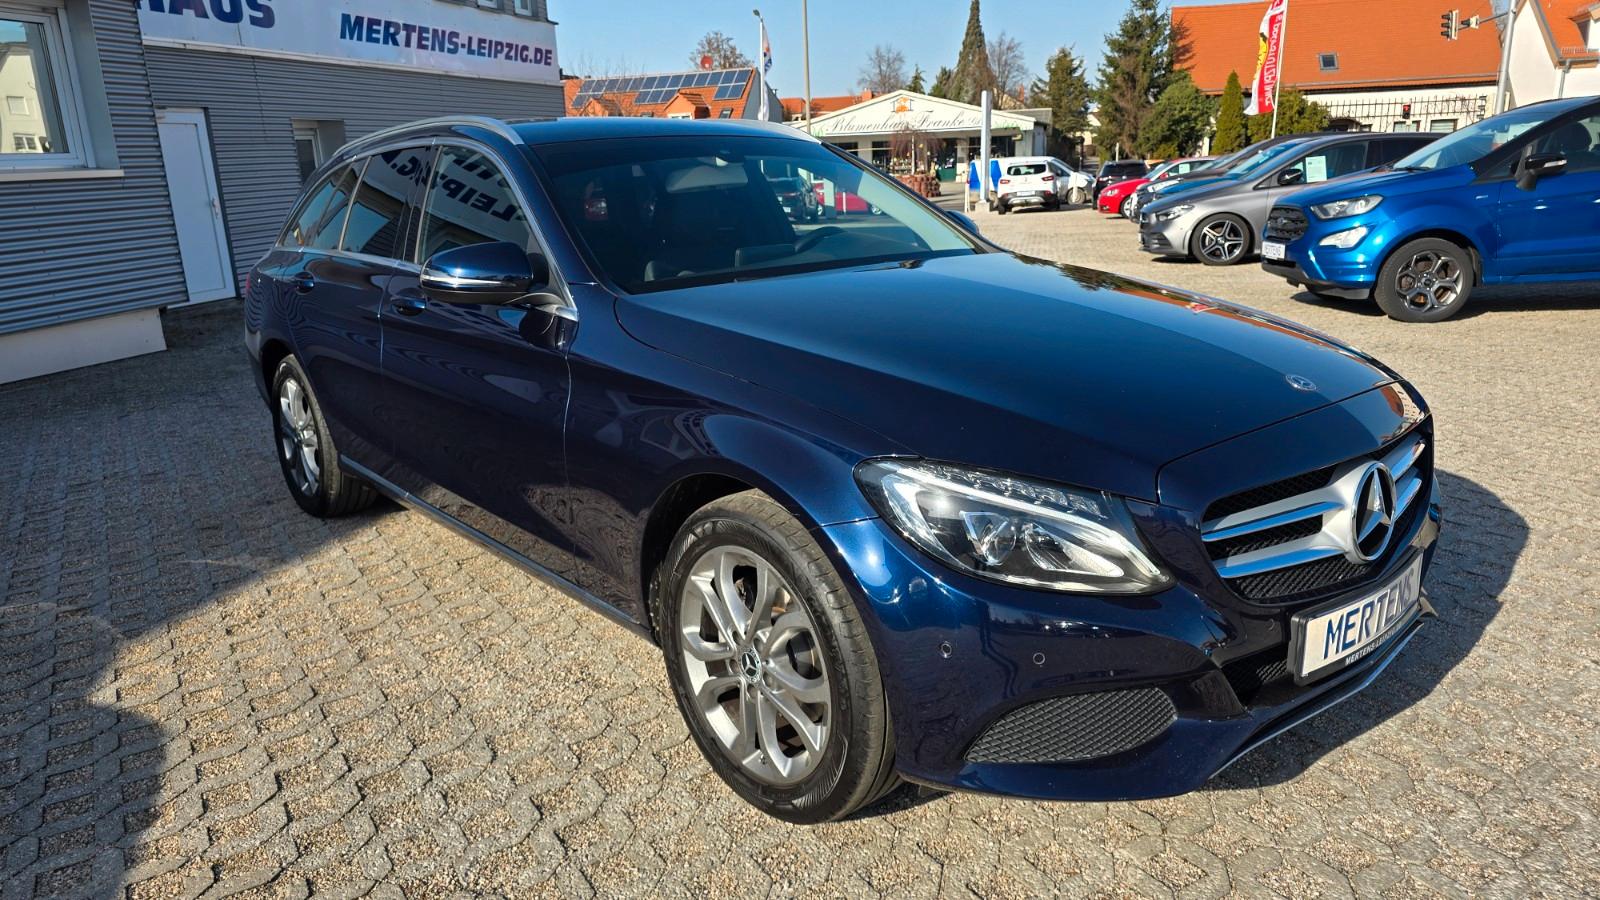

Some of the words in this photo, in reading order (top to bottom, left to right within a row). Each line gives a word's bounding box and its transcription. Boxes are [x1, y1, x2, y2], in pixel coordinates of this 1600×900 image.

[340, 13, 553, 66] MERTENS-LEIPZIG.DE
[913, 109, 965, 129] Franke
[1323, 566, 1415, 660] MERTENS
